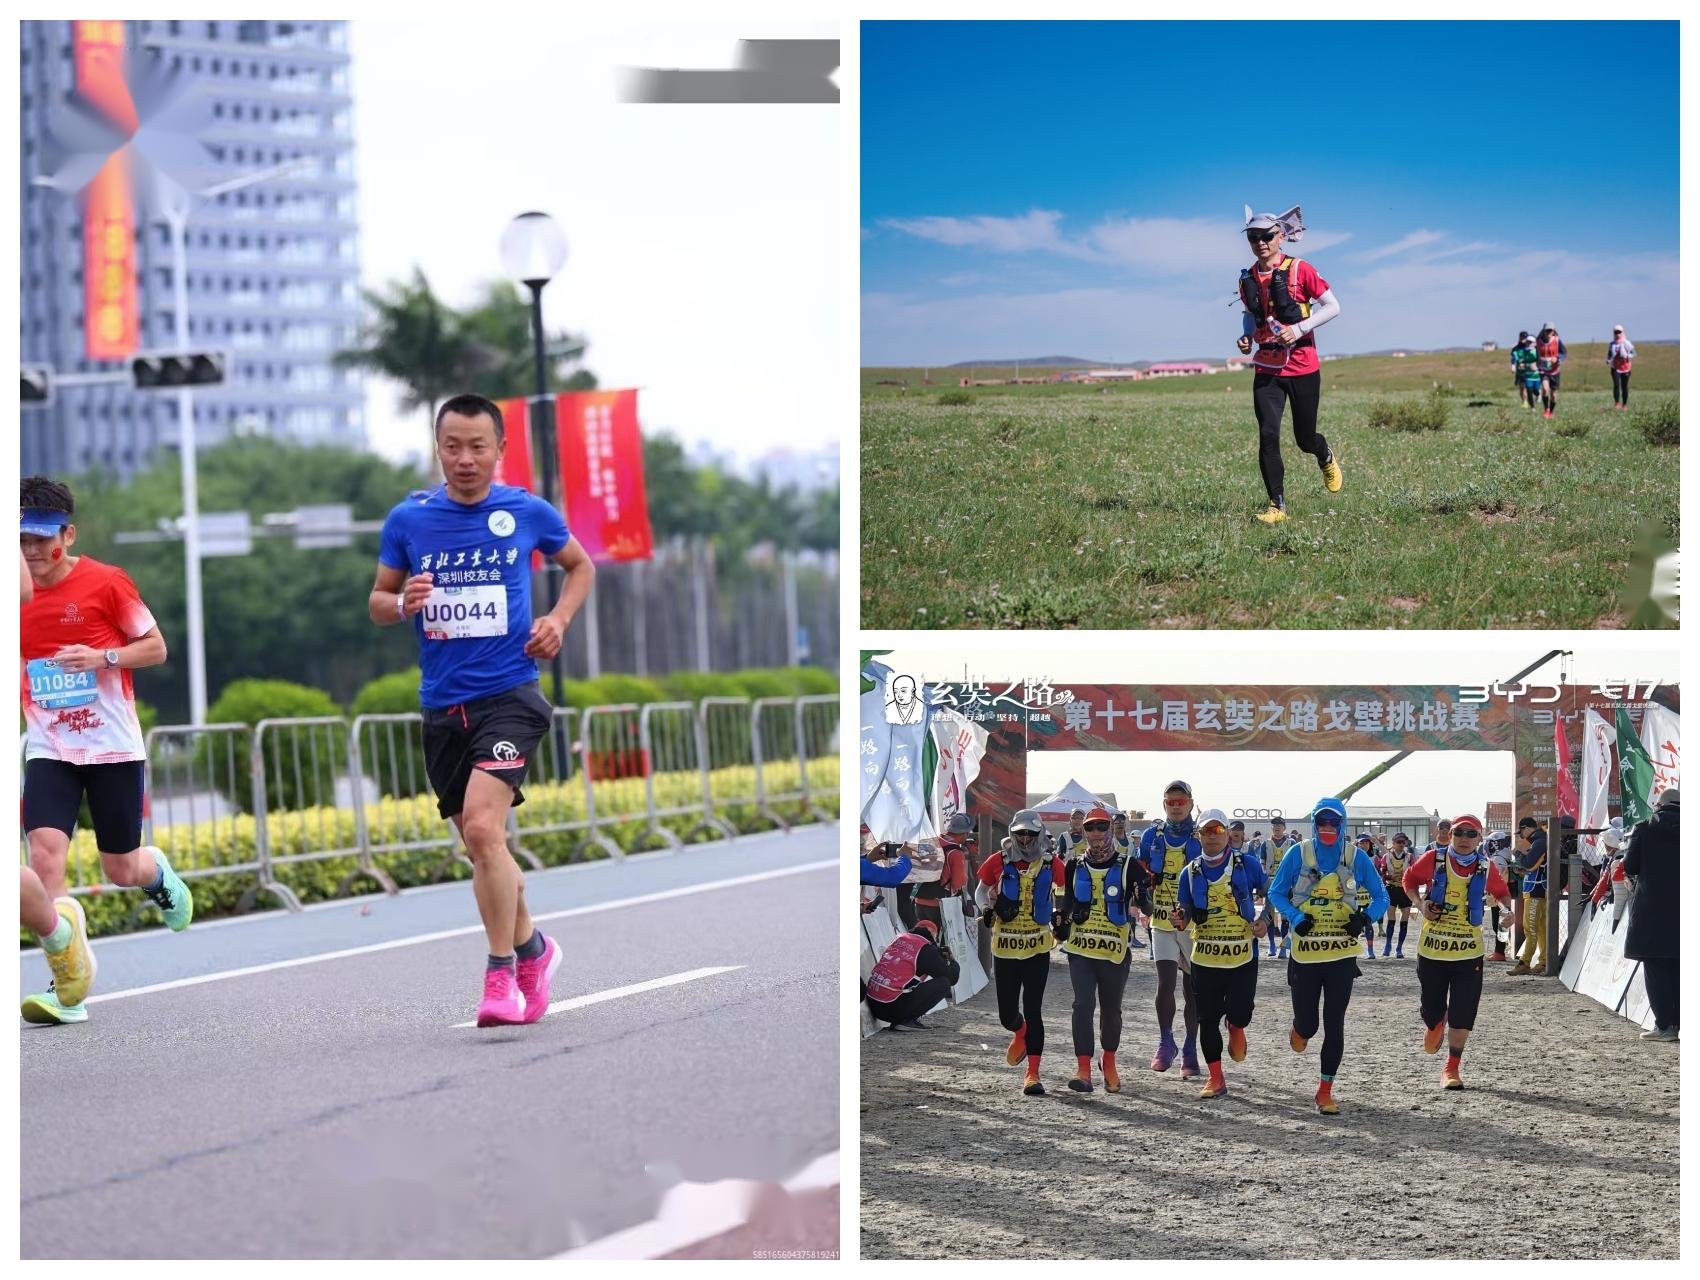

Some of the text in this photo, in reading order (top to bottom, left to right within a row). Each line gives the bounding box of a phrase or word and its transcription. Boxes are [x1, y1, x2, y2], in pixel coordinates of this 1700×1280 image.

[420, 547, 518, 570] 西北工业大学
[438, 568, 501, 584] 深圳校友会
[424, 601, 497, 622] U0044
[31, 671, 88, 693] U1084
[1063, 700, 1480, 732] 第十七届玄奘之路戈壁挑战赛
[1070, 936, 1122, 953] M09A03
[1195, 942, 1249, 956] M09A04
[1423, 935, 1477, 951] M09A06
